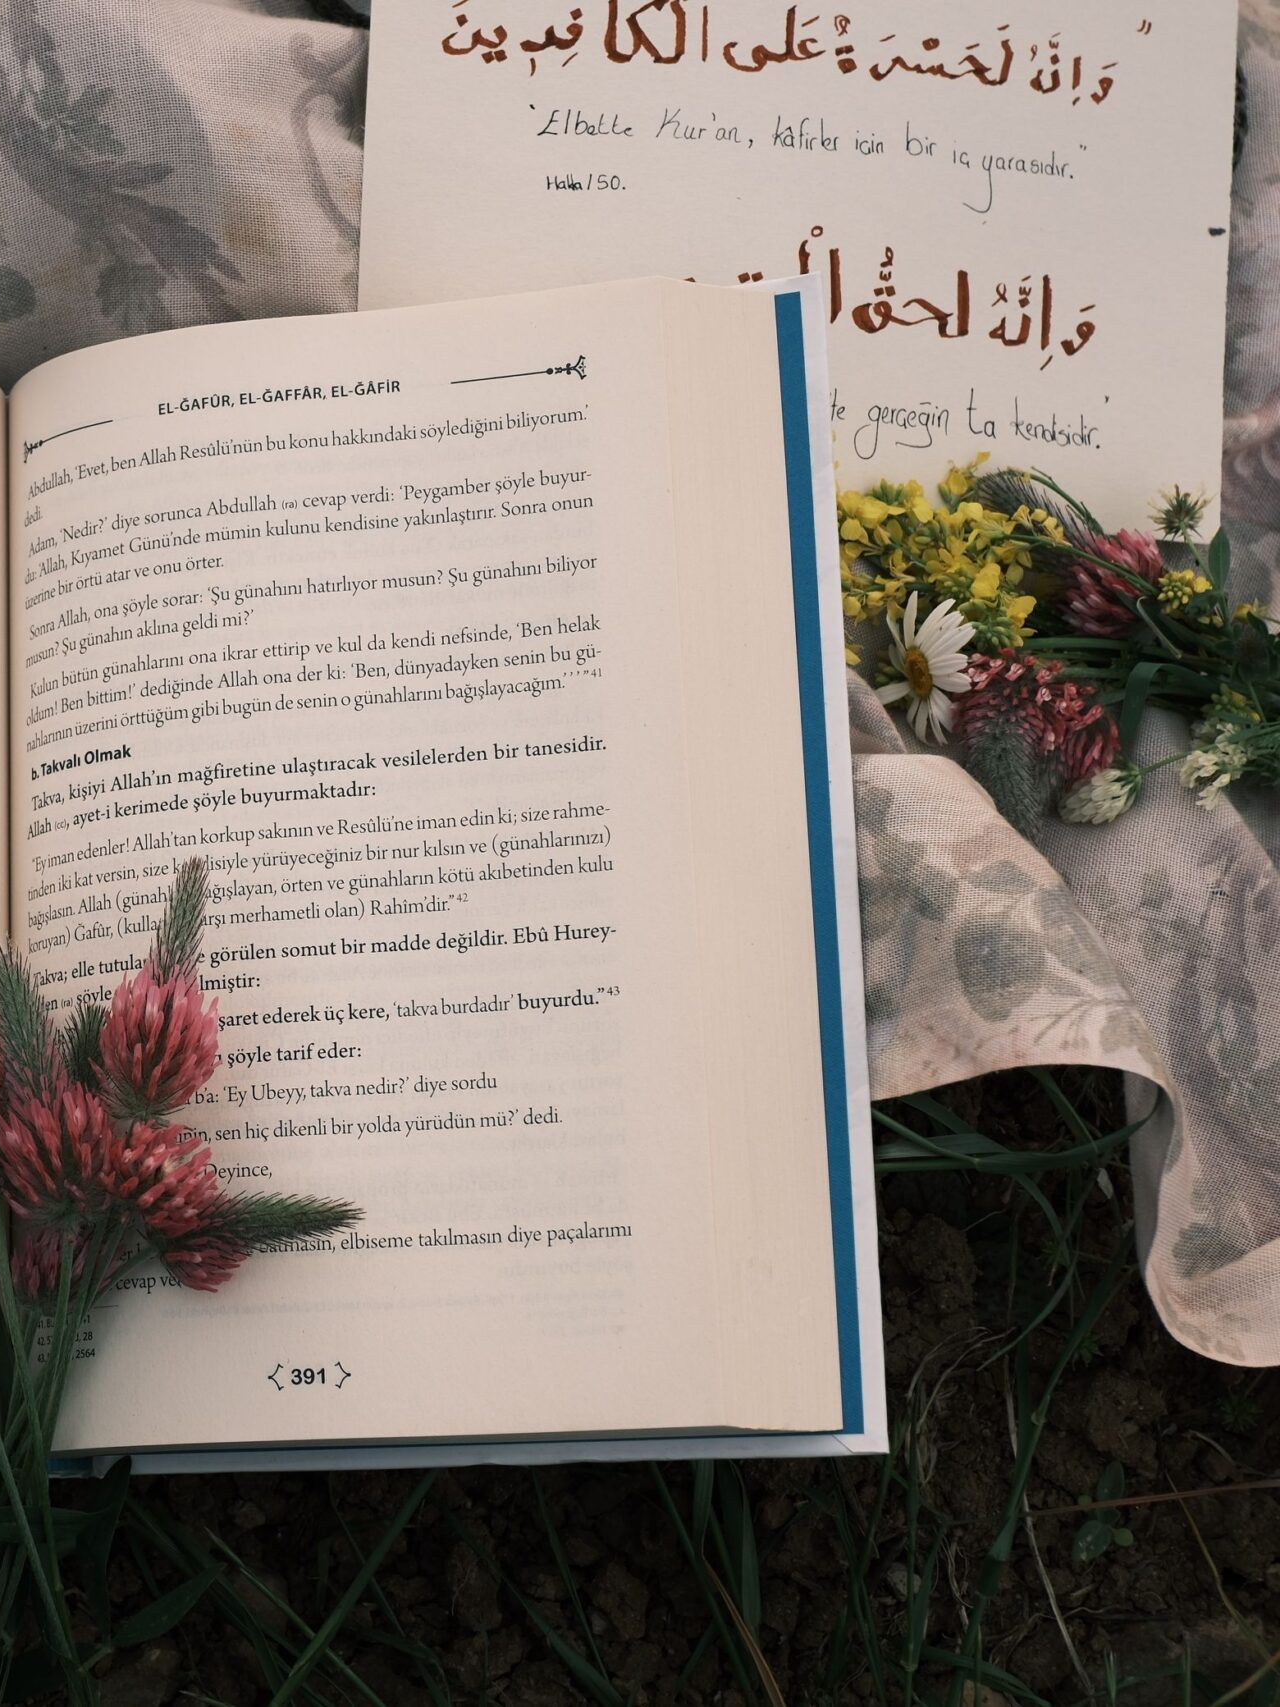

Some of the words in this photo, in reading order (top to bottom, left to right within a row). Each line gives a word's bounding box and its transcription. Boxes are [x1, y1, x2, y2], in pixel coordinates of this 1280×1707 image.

[905, 121, 937, 156] bir
[966, 387, 996, 439] ta
[110, 456, 137, 472] ben
[138, 445, 177, 467] Allah
[265, 434, 287, 452] bu
[288, 433, 329, 450] konu
[331, 424, 417, 447] hakkındaki
[420, 417, 504, 443] söylediğini
[31, 767, 40, 782] b.
[40, 753, 81, 777] Takvalı
[83, 743, 132, 765] Olmak
[31, 791, 65, 812] Takva,
[68, 778, 106, 802] kişiyi
[109, 769, 173, 793] Allah’ın
[177, 761, 276, 787] mağfiretine
[281, 752, 377, 777] ulaştıracak
[380, 745, 489, 768] vesilelerden
[492, 742, 520, 760] bir
[524, 734, 607, 757] tanesidir.
[209, 942, 277, 969] görülen
[280, 941, 337, 958] somut
[340, 937, 367, 955] bir
[370, 933, 431, 954] madde
[435, 928, 508, 954] değildir.
[512, 925, 550, 945] Ebû
[215, 1011, 259, 1034] şaret
[262, 1004, 322, 1025] ederek
[323, 1005, 345, 1026] üç
[347, 1002, 390, 1022] kere,
[227, 1045, 272, 1070] şöyle
[275, 1042, 315, 1062] tarif
[316, 1041, 362, 1060] eder:
[250, 1082, 307, 1105] Ubeyy,
[309, 1079, 352, 1098] takva
[413, 1074, 448, 1098] diye
[451, 1071, 498, 1091] sordu
[215, 1128, 242, 1142] sen
[244, 1121, 270, 1143] hiç
[272, 1117, 328, 1138] dikenli
[330, 1116, 354, 1135] bir
[356, 1114, 402, 1140] yolda
[404, 1111, 476, 1138] yürüdün
[522, 1105, 563, 1126] dedi.
[340, 1229, 413, 1251] elbiseme
[418, 1227, 502, 1247] takılmasın
[507, 1224, 542, 1249] diye
[546, 1220, 633, 1248] paçalarımı
[290, 1367, 326, 1386] 391
